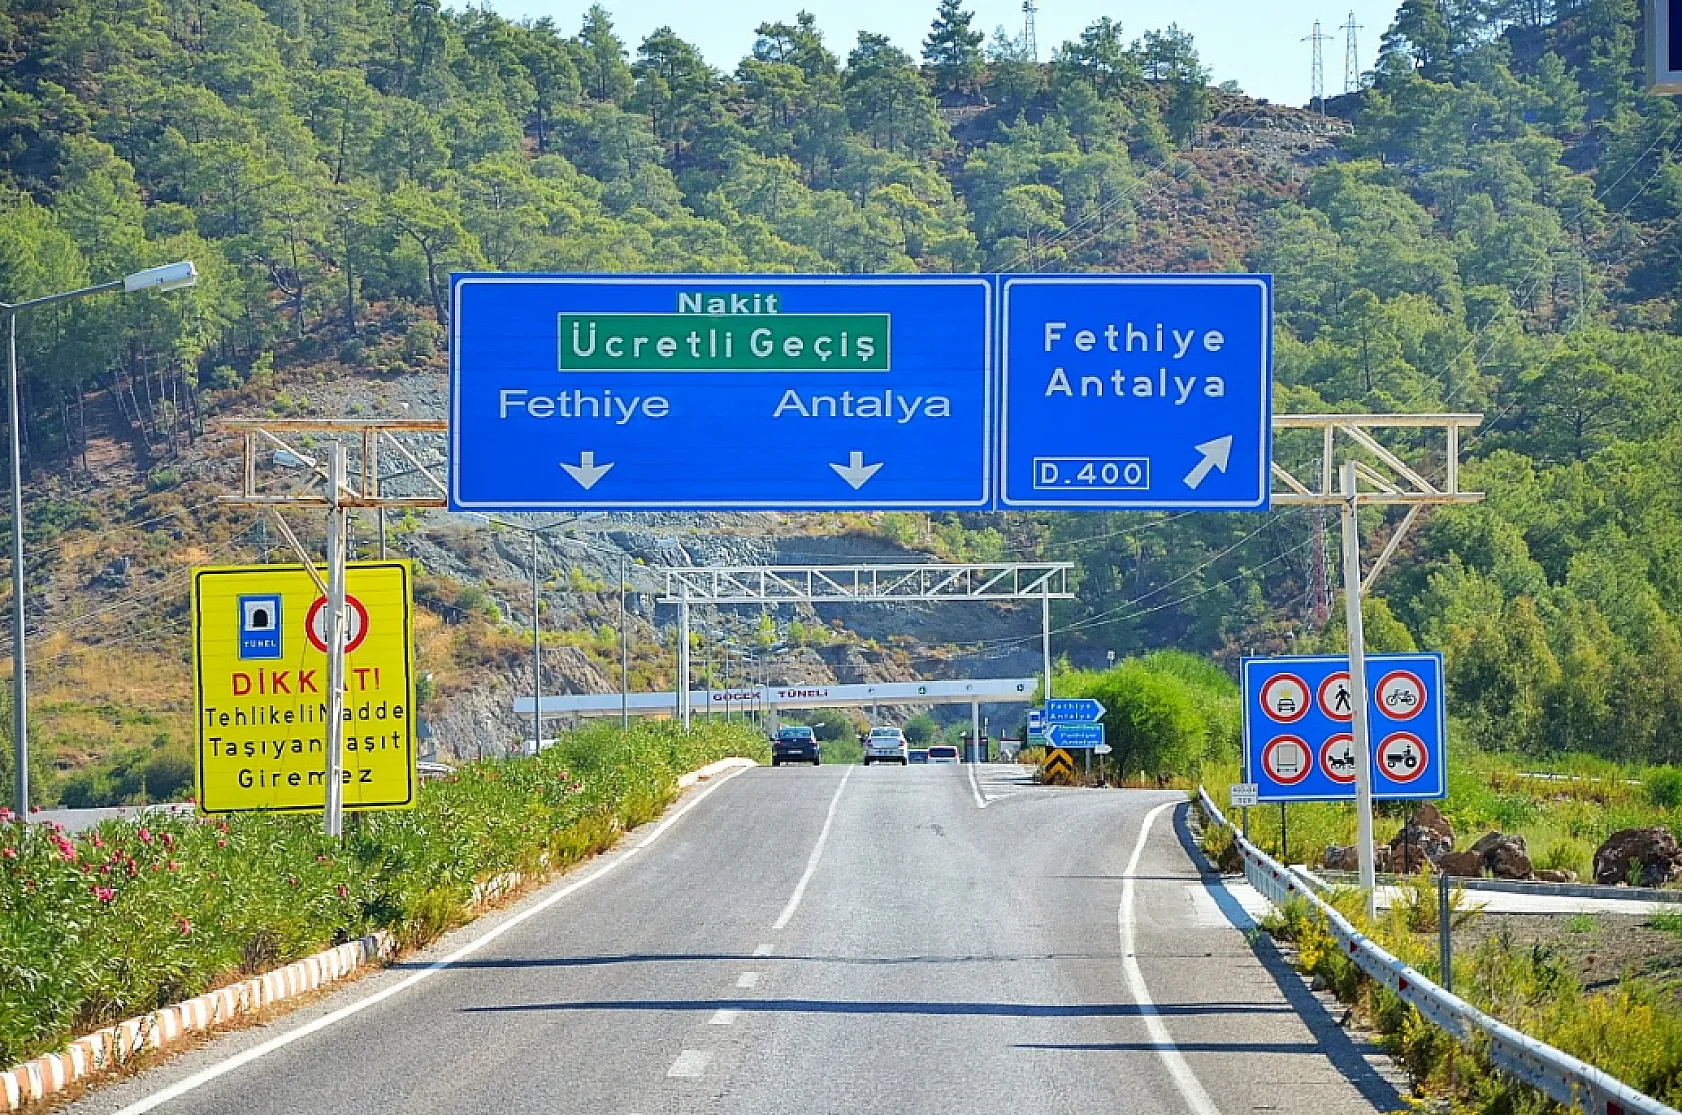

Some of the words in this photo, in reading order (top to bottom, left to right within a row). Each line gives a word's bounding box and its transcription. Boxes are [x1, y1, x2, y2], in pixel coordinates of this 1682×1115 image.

[678, 292, 778, 312] Nakit
[572, 321, 733, 358] Ücretli
[750, 327, 876, 362] Geçiş
[1044, 322, 1225, 359] Fethiye
[1044, 368, 1225, 405] Antalya
[500, 389, 669, 425] Fethiye
[773, 389, 951, 424] Antalya
[1040, 462, 1143, 485] D.400
[232, 667, 380, 696] DİKKT!
[204, 703, 313, 728] Tehlikeli
[209, 736, 322, 760] Taşıyan
[346, 730, 401, 754] aşıt
[238, 768, 373, 789] Giremez
